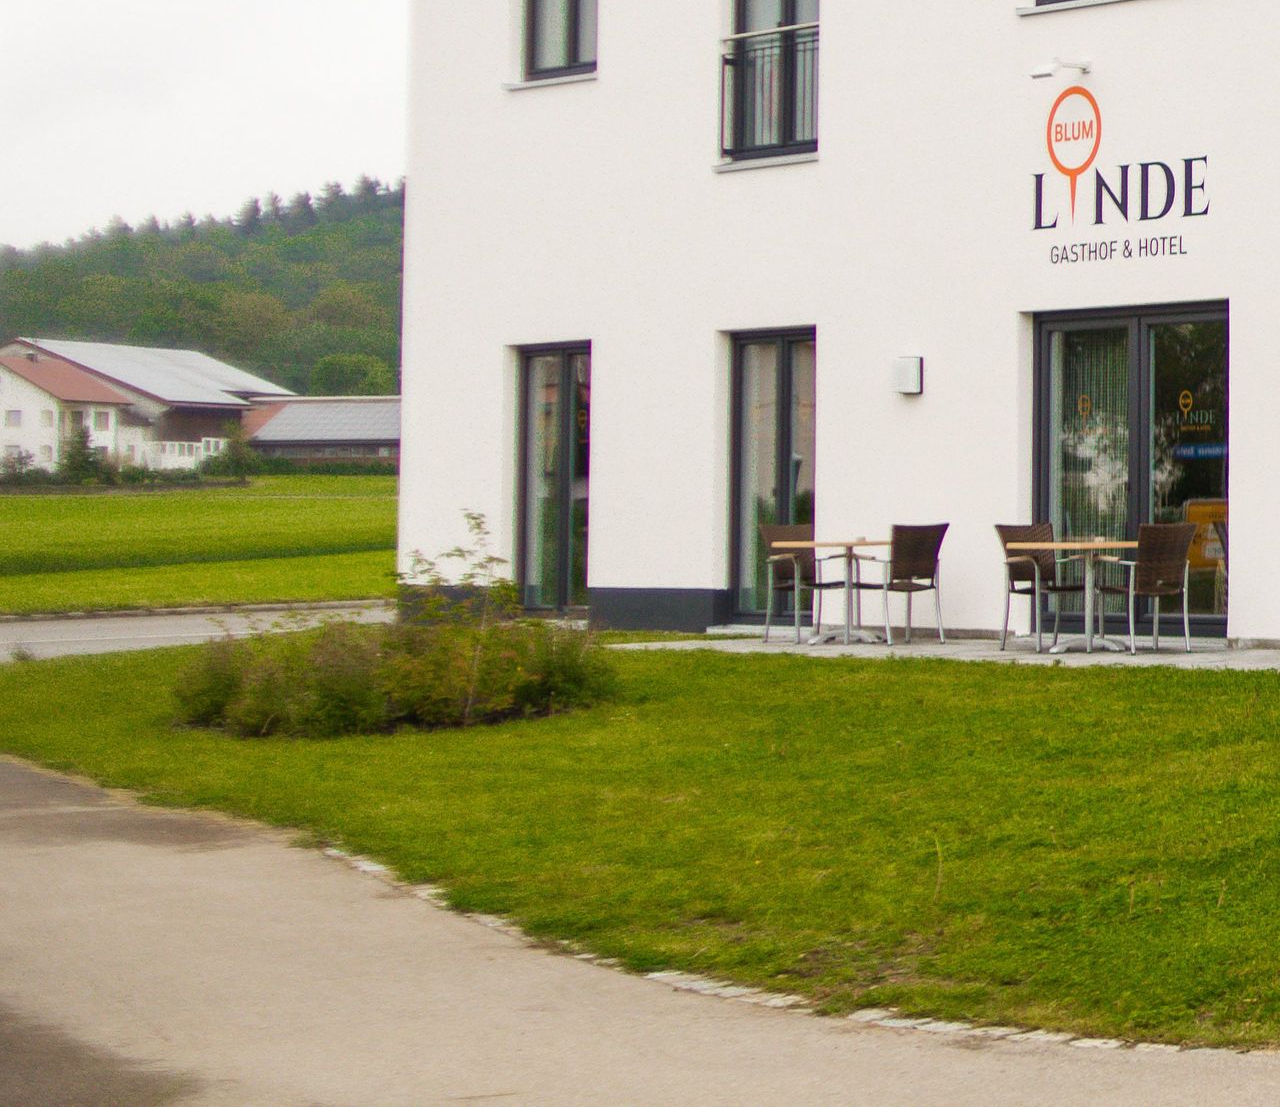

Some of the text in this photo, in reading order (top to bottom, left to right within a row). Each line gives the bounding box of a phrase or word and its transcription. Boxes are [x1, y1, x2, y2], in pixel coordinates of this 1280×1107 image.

[1054, 120, 1094, 142] BLUM
[1031, 155, 1210, 230] LINDE
[1050, 235, 1187, 264] GASTHOF & HOTEL
